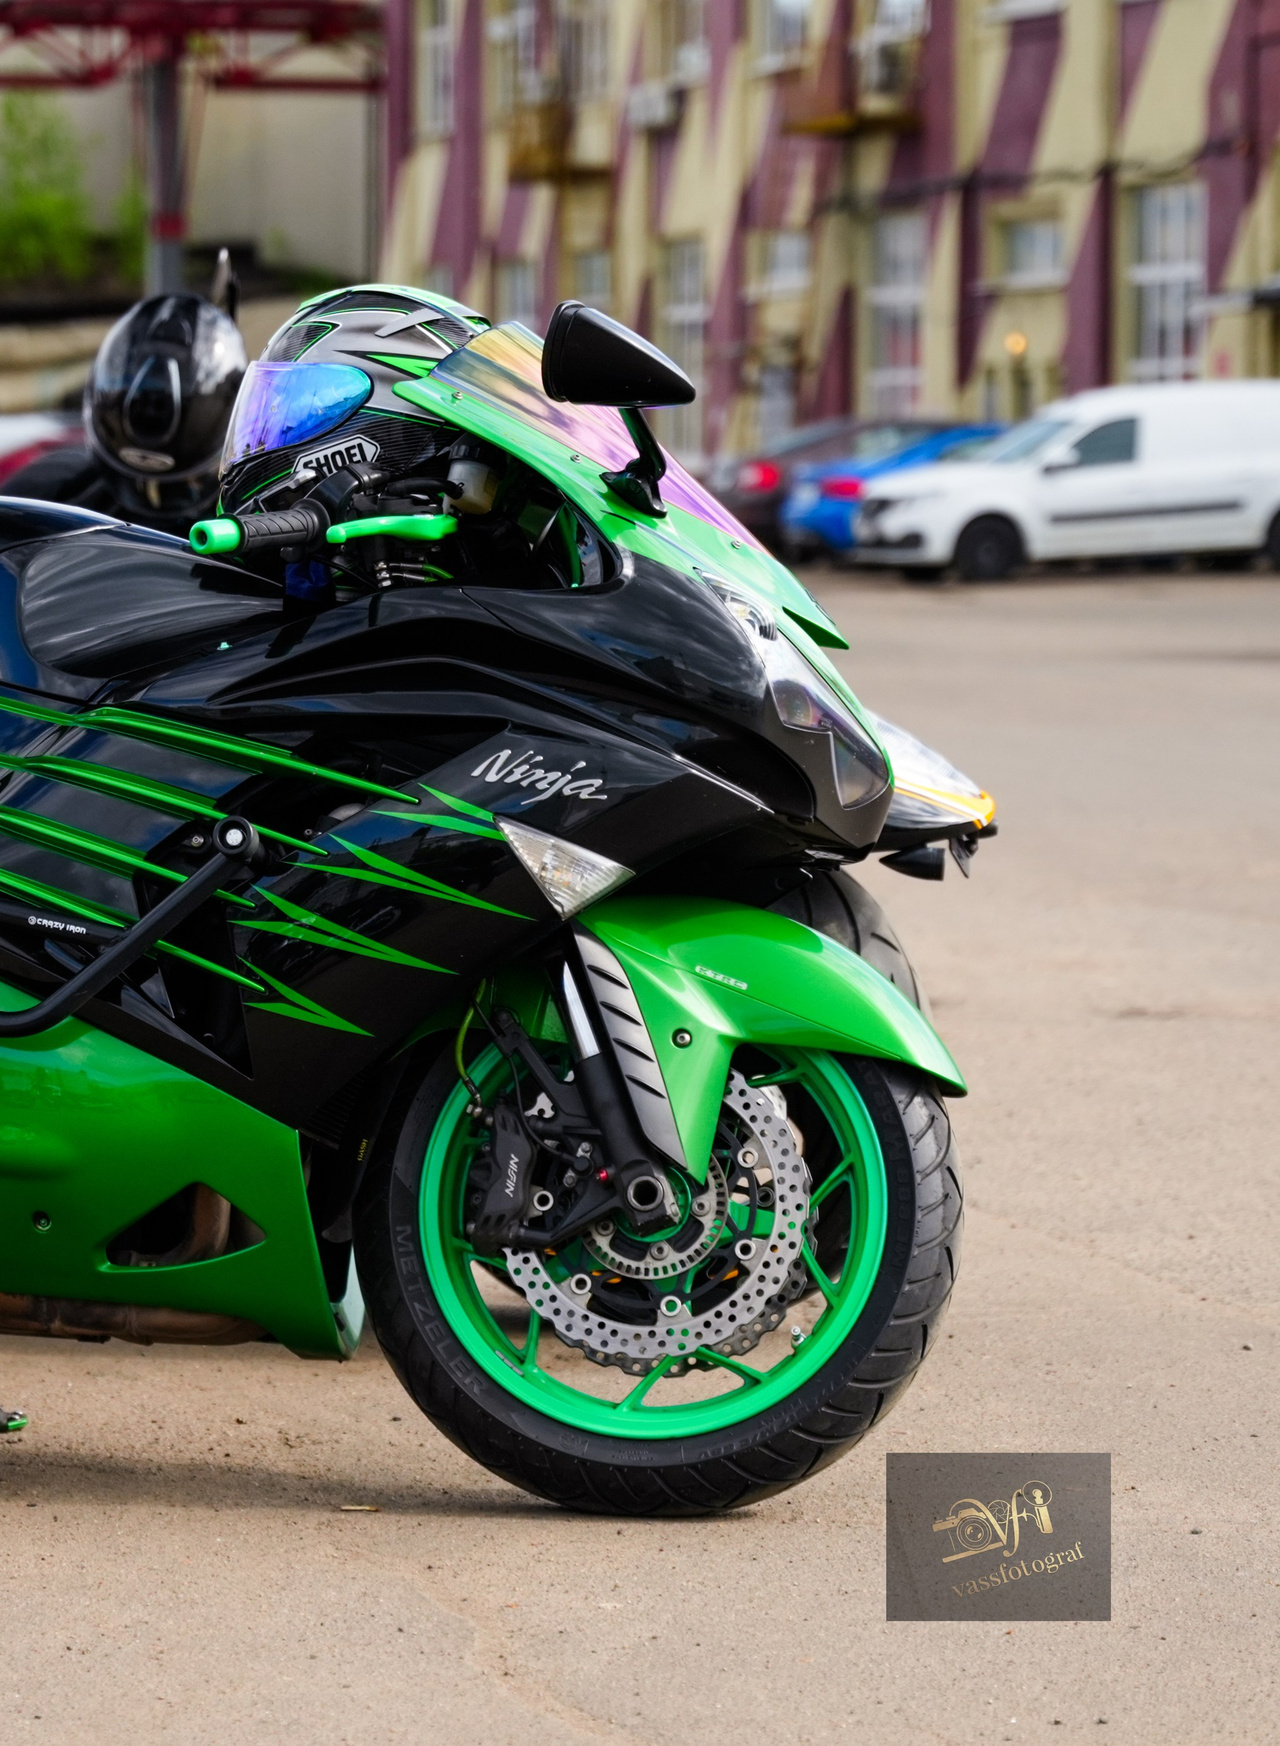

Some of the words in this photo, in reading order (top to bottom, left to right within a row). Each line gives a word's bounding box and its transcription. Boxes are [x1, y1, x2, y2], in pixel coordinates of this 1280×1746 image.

[303, 442, 368, 478] SHOEI
[471, 749, 607, 805] Ninja
[37, 918, 65, 931] CRAZY
[66, 924, 87, 934] IRON
[395, 1225, 489, 1397] METZELER
